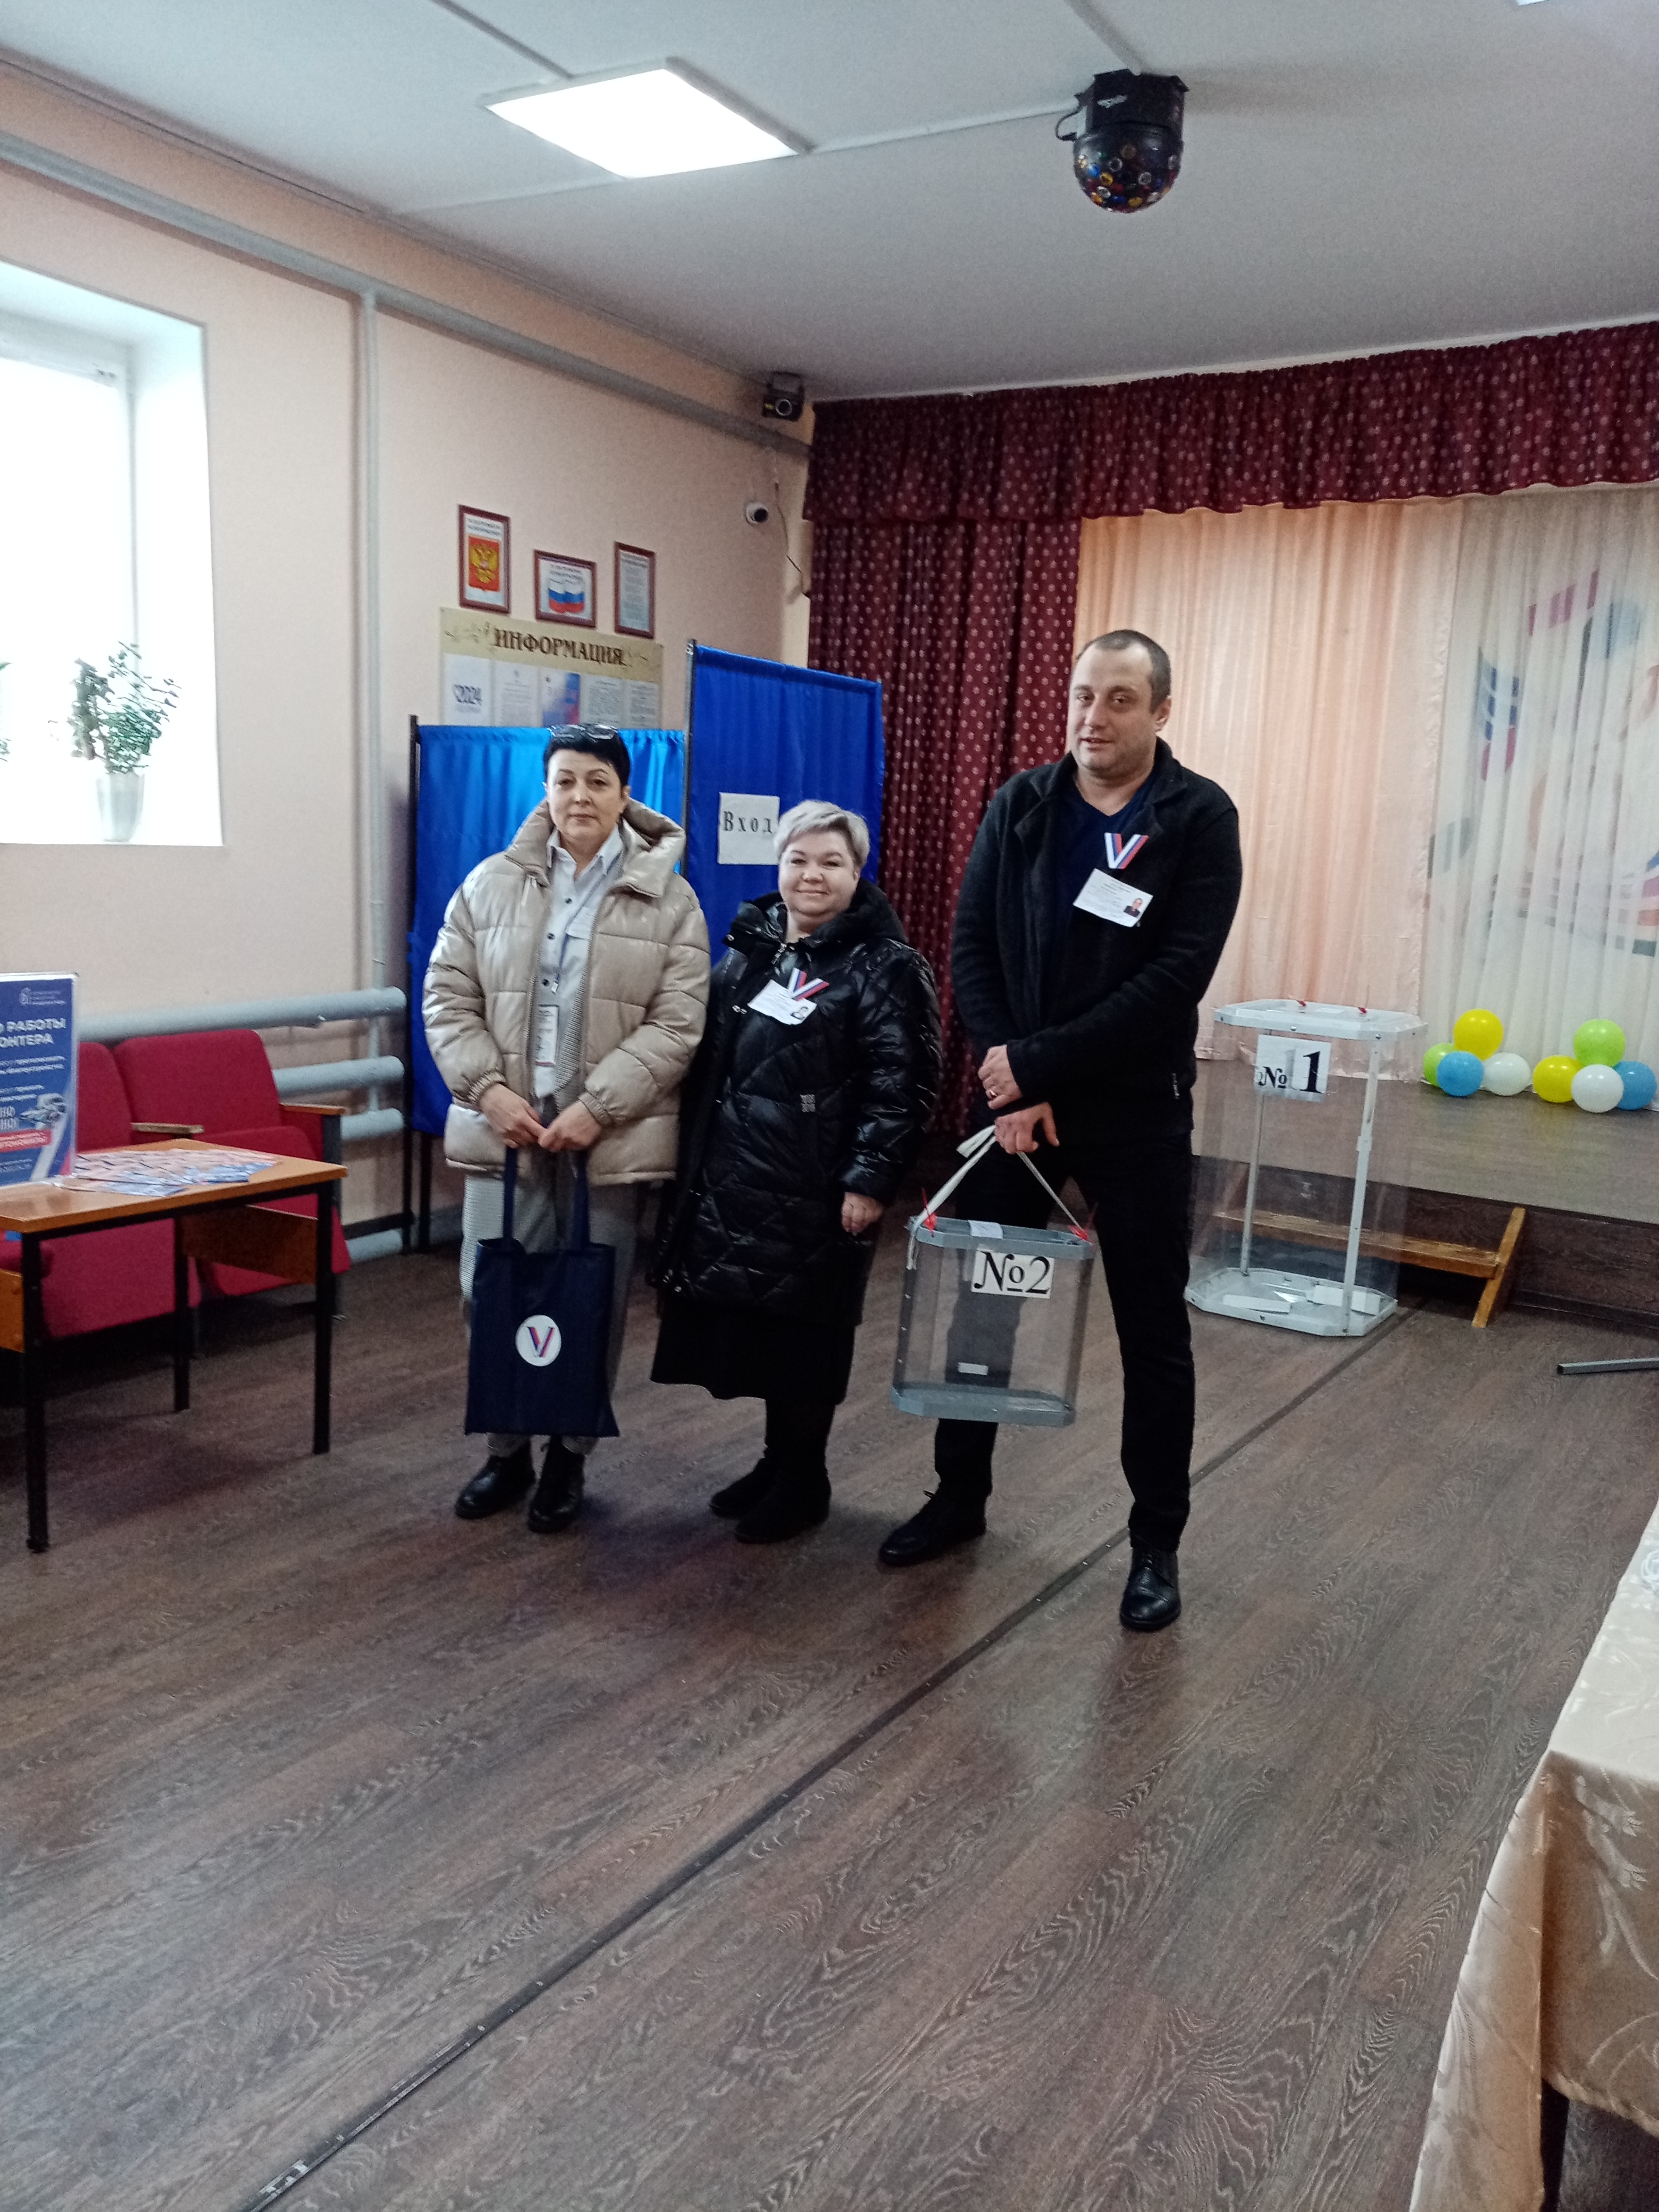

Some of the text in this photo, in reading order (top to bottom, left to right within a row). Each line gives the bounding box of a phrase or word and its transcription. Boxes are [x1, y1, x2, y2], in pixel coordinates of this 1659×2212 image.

[494, 627, 627, 666] ИНФОРМАЦИЯ
[723, 811, 773, 834] Вход
[6, 1017, 66, 1033] РАБОТЫ
[1299, 1051, 1323, 1094] 1
[526, 1326, 555, 1358] V
